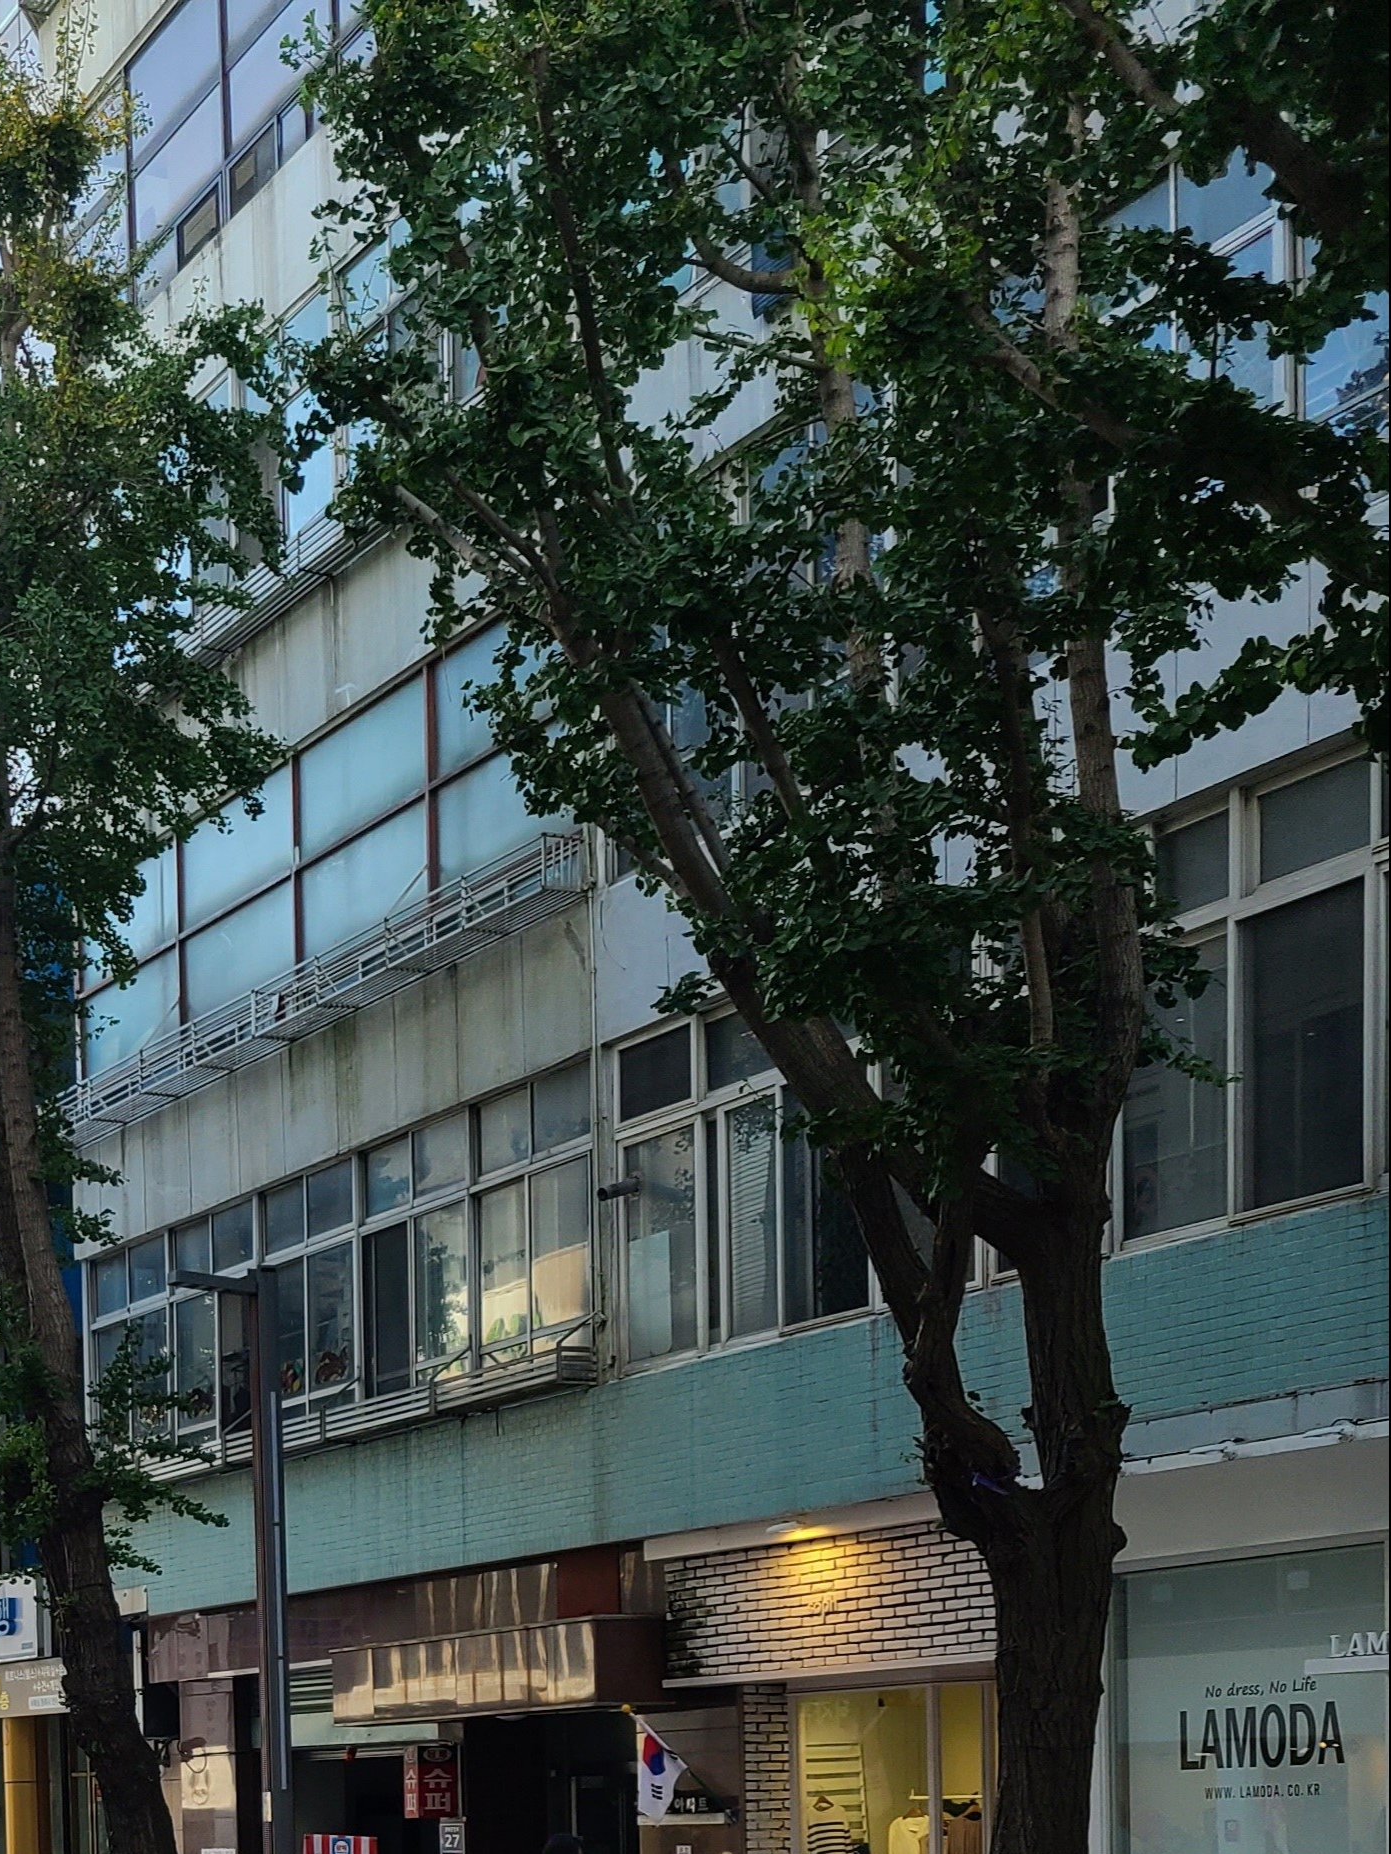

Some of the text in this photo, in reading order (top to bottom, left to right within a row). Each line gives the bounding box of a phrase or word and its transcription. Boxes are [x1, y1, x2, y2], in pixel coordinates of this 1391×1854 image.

[1205, 1676, 1317, 1698] No dress, No Life
[1180, 1701, 1345, 1771] LAMODA
[423, 1768, 453, 1812] 슈퍼
[445, 1835, 460, 1848] 27
